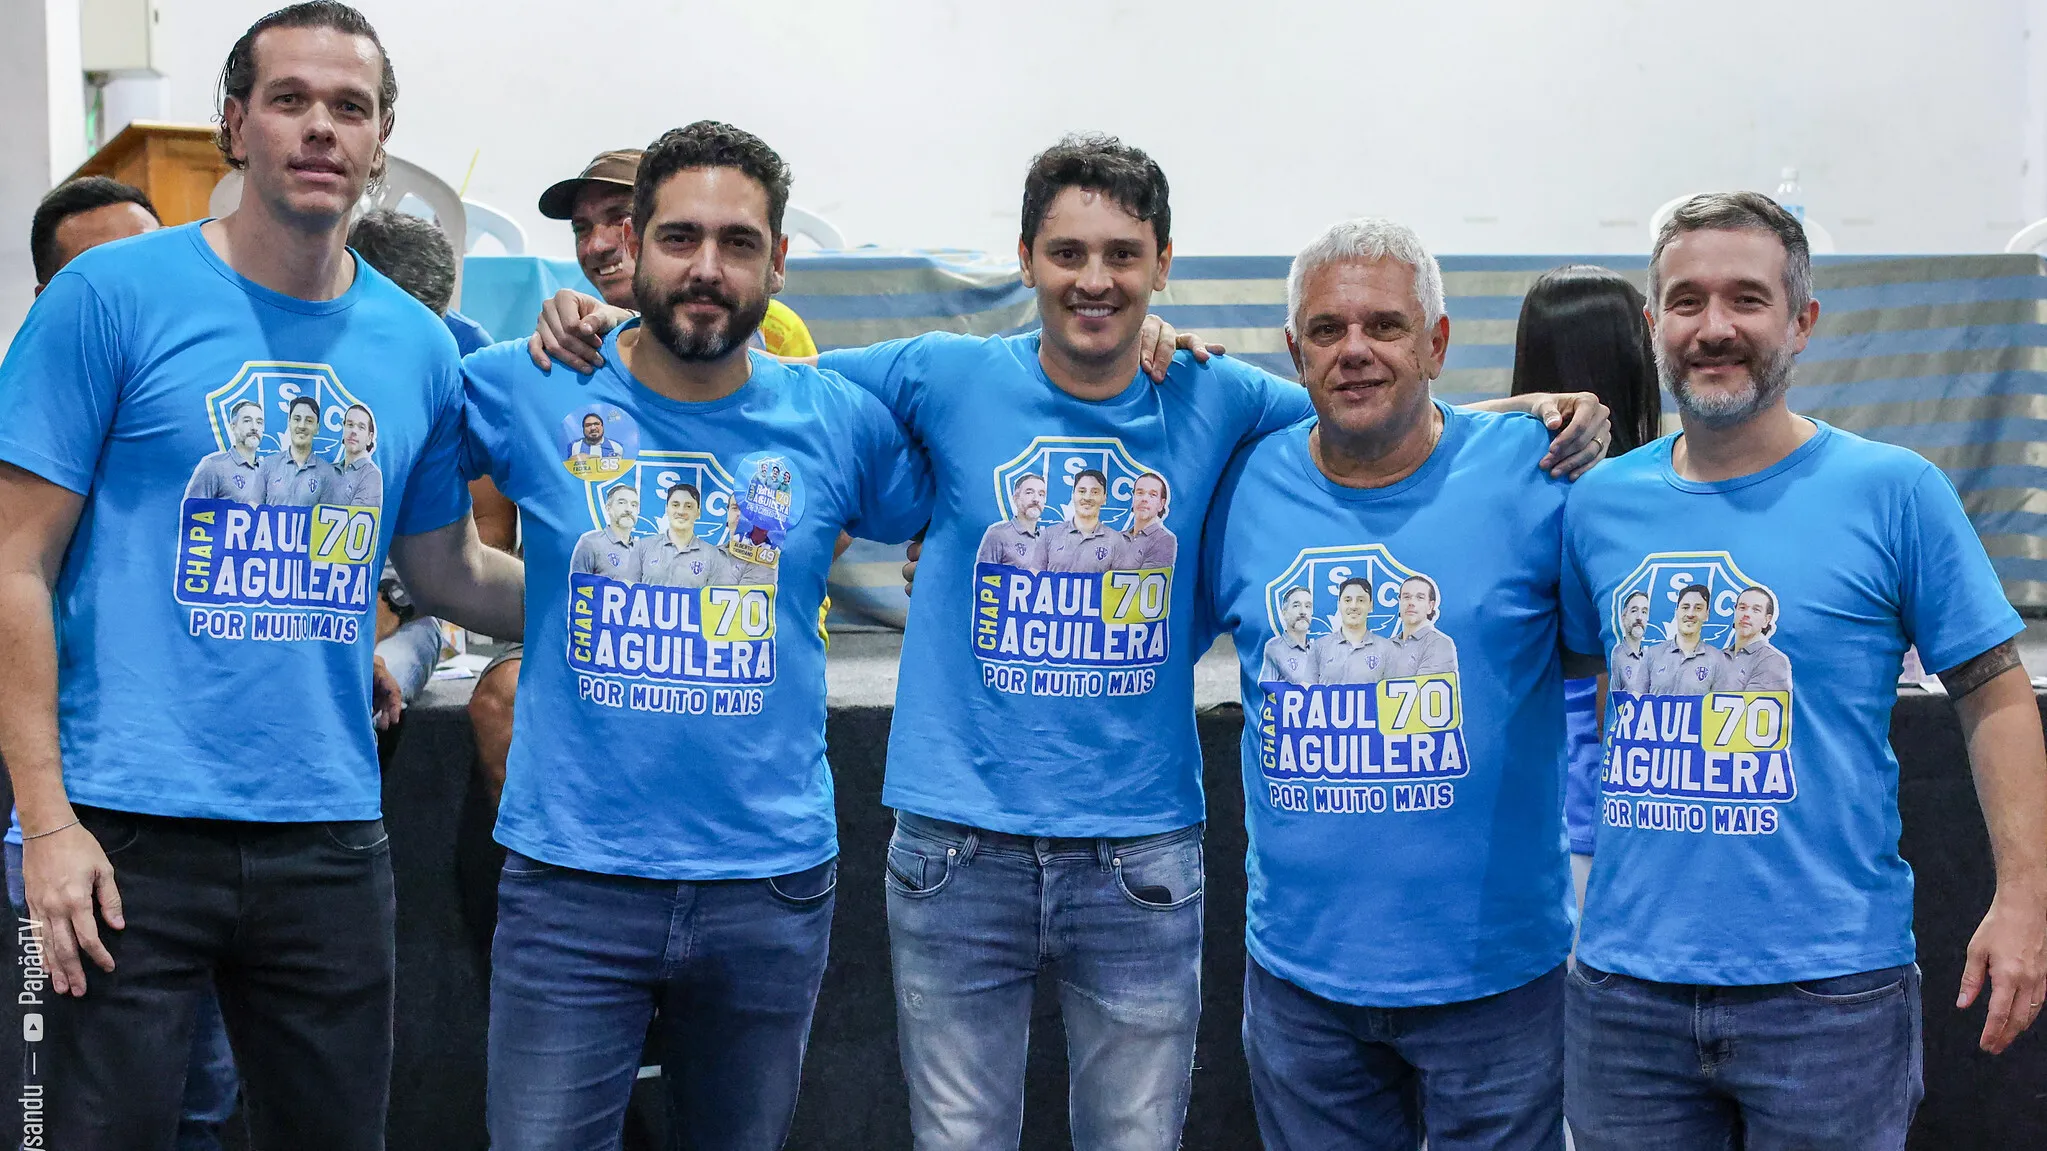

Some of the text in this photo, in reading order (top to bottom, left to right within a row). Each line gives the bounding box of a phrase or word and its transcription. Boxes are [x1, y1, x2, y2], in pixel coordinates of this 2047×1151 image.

[600, 458, 620, 471] 35
[778, 491, 790, 505] 70
[185, 511, 216, 593] CHAPA
[224, 507, 376, 561] RAUL 70
[759, 549, 776, 563] 49
[213, 556, 366, 605] AGUILERA
[1007, 573, 1166, 619] RAUL 70
[191, 611, 357, 643] POR MUITO MAIS
[574, 585, 594, 662] CHAPA
[601, 586, 769, 637] RAUL 70
[977, 575, 1002, 650] CHAPA
[595, 630, 771, 678] AGUILERA
[999, 617, 1164, 660] AGUILERA
[580, 677, 762, 714] POR MUITO MAIS
[984, 666, 1154, 696] POR MUITO MAIS
[1282, 679, 1453, 730] RAUL 70
[1263, 692, 1277, 769] CHAPA
[1615, 700, 1699, 744] RAUL
[1712, 695, 1783, 748] 70
[1279, 733, 1461, 773] AGUILERA
[1609, 745, 1787, 794] AGUILERA
[1271, 784, 1453, 812] POR MUITO MAIS
[1638, 804, 1705, 832] MUITO
[1715, 807, 1777, 834] MAIS
